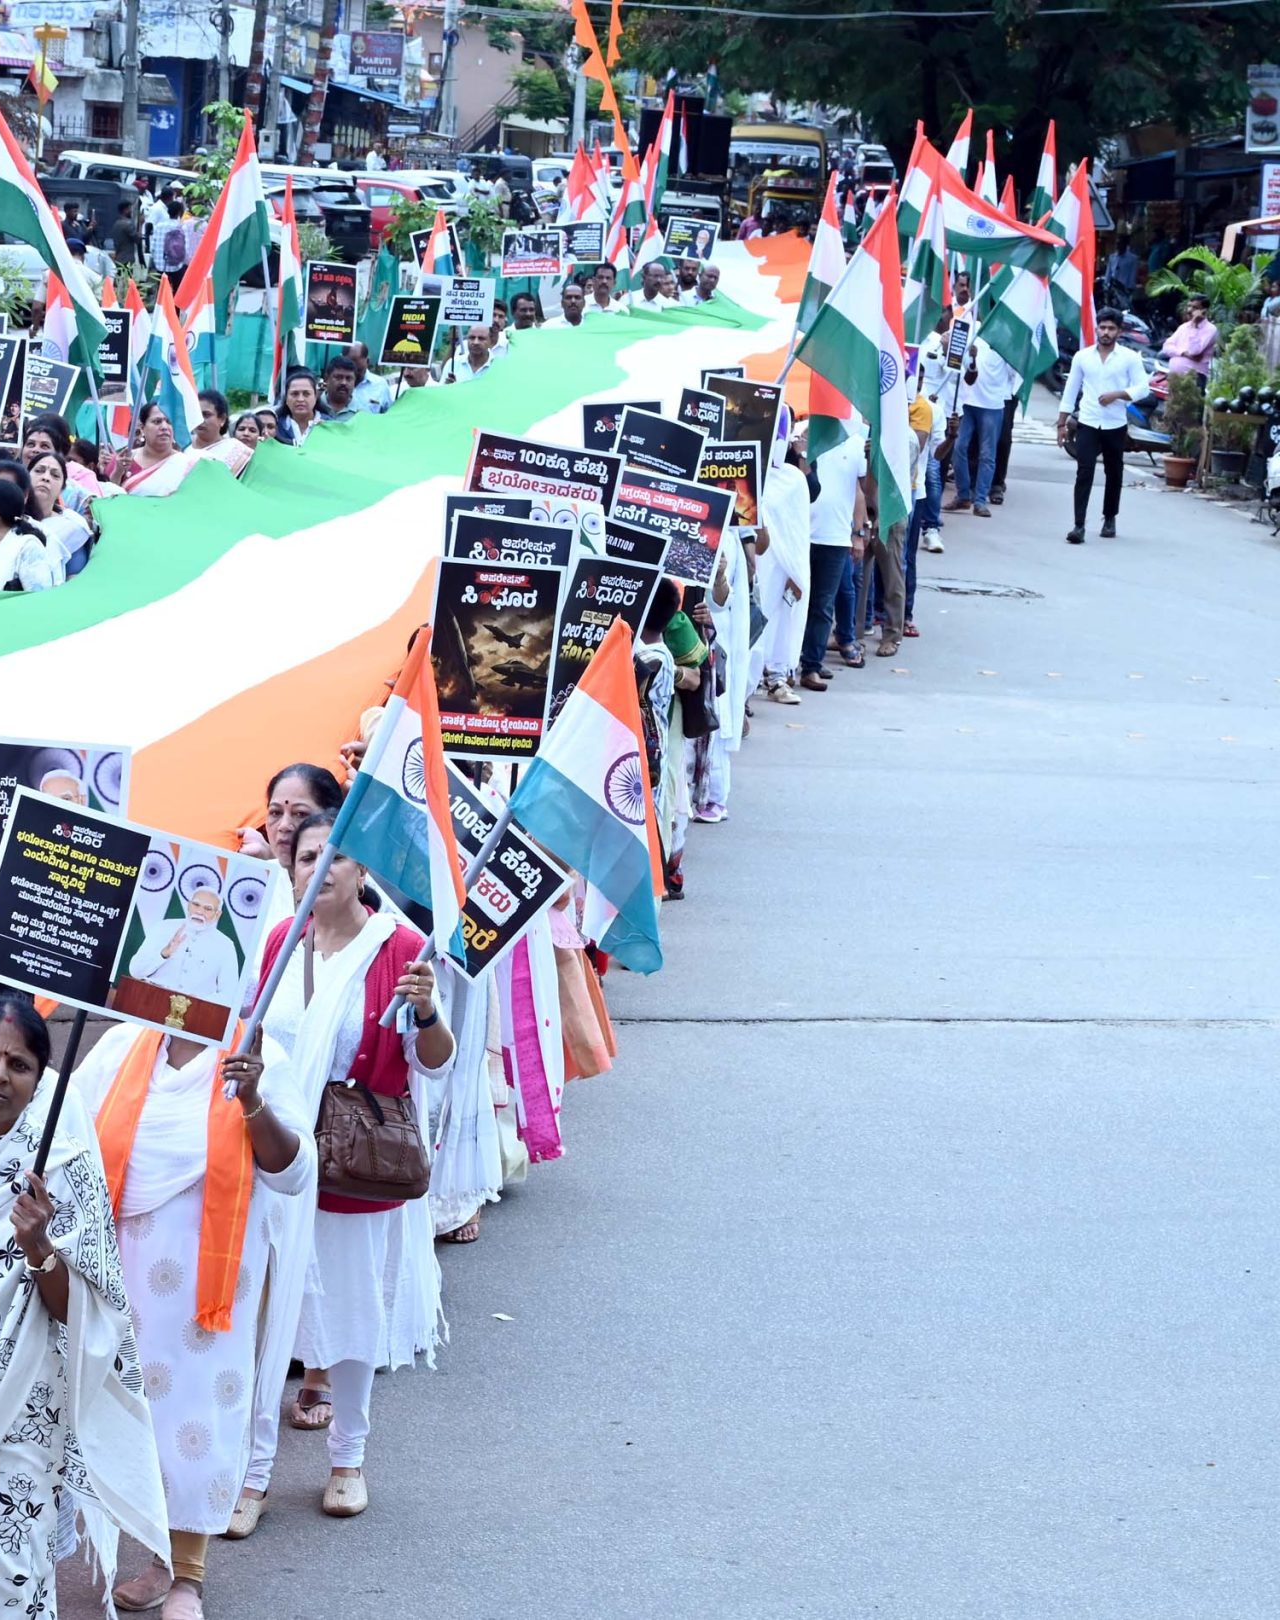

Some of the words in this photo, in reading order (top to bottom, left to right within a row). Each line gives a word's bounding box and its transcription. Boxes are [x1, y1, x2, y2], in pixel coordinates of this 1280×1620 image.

[354, 65, 397, 75] JEWELLERY
[361, 57, 392, 65] MARUTI
[519, 450, 571, 477] 100ಕ್ಕೂ
[573, 457, 608, 484] ಹೆಚ್ಚು
[501, 538, 556, 553] ಆಪರೇಷನ್
[606, 533, 635, 552] ERATION
[576, 580, 637, 606] ಸಿಂಧೂರ
[600, 575, 644, 590] ಆಪರೇಷನ್
[461, 585, 538, 610] ಸಿಂಧೂರ
[52, 823, 103, 848] ಸಿಂಧೂರ
[70, 848, 97, 864] ಹಾಗೂ
[99, 858, 138, 877] ಮಾತುಕತೆ
[500, 846, 543, 900] ಹೆಚ್ಚು
[48, 871, 86, 894] ಸಾಧ್ಯವಿಲ್ಲ
[95, 871, 121, 887] ಇರಲು
